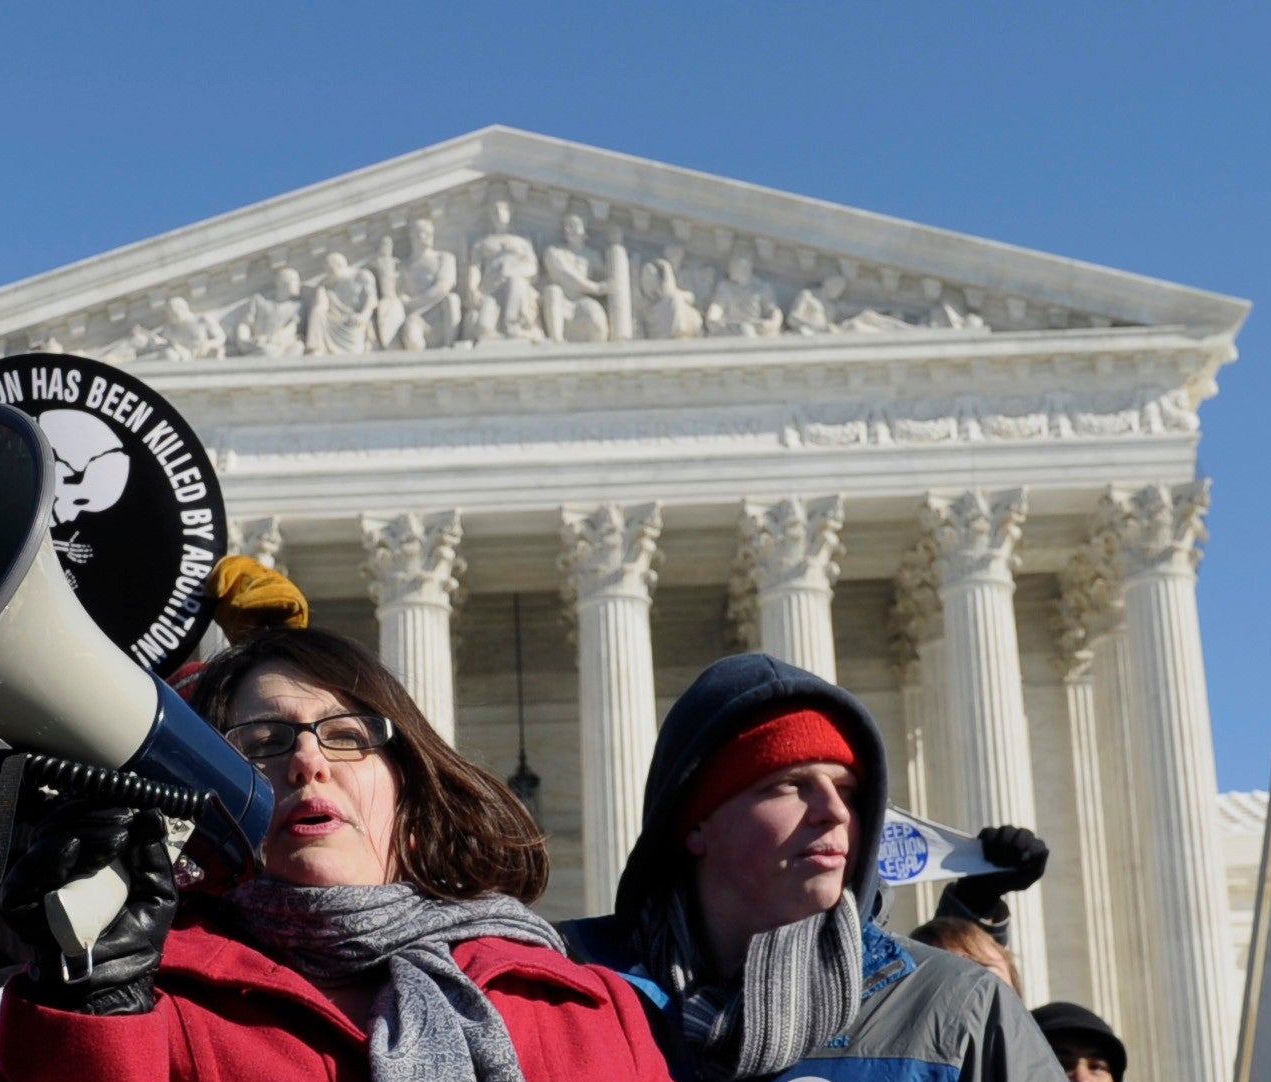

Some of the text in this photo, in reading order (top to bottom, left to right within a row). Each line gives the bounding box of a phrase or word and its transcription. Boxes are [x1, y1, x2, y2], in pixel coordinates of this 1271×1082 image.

[31, 367, 81, 402] HAS
[85, 376, 154, 433] BEEN
[142, 419, 207, 503] KILLED
[180, 508, 215, 541] BY
[882, 823, 913, 841] EEP
